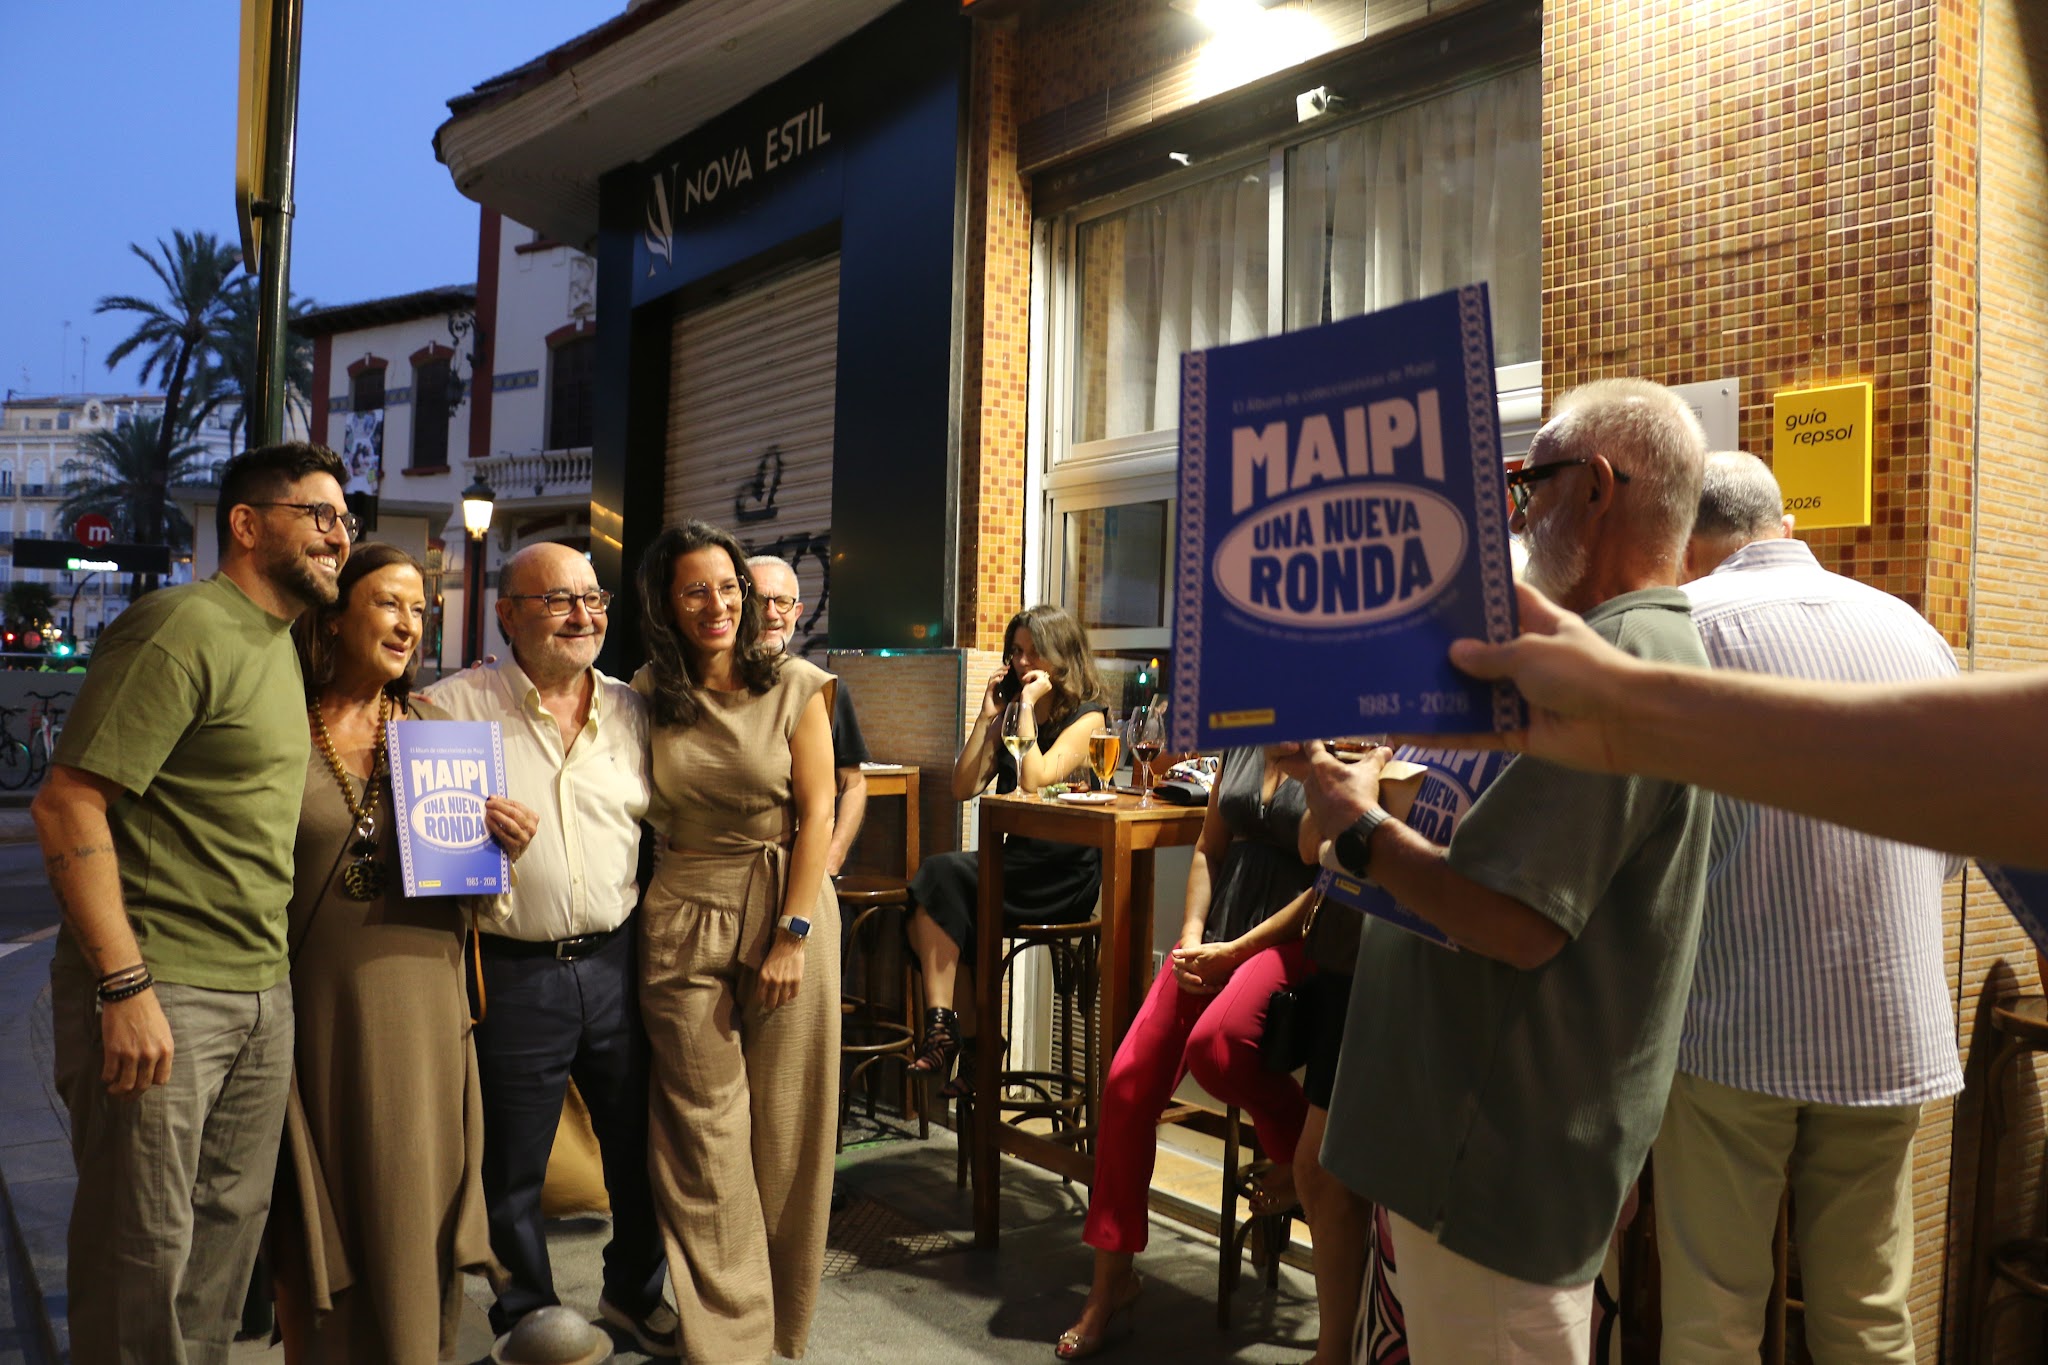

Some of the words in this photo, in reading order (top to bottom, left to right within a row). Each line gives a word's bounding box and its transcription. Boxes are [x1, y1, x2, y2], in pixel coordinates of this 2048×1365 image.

[685, 146, 752, 213] NOVA
[765, 102, 831, 172] ESTIL
[1785, 408, 1827, 430] guía
[1793, 424, 1853, 446] repsol
[1232, 390, 1445, 515] MAIPI
[1784, 496, 1821, 510] 2026
[1254, 508, 1313, 550] UNA
[1323, 500, 1420, 542] NUEVA
[1250, 538, 1432, 614] RONDA
[1359, 695, 1400, 716] 1983
[1420, 693, 1470, 714] 2026
[411, 760, 488, 798] MAIPI
[1416, 775, 1459, 814] NUEVA
[424, 800, 446, 814] UNA
[449, 797, 481, 814] NUEVA
[424, 816, 486, 843] RONDA
[1406, 803, 1454, 846] NDA
[466, 877, 478, 886] 1983
[484, 876, 497, 886] 2026
